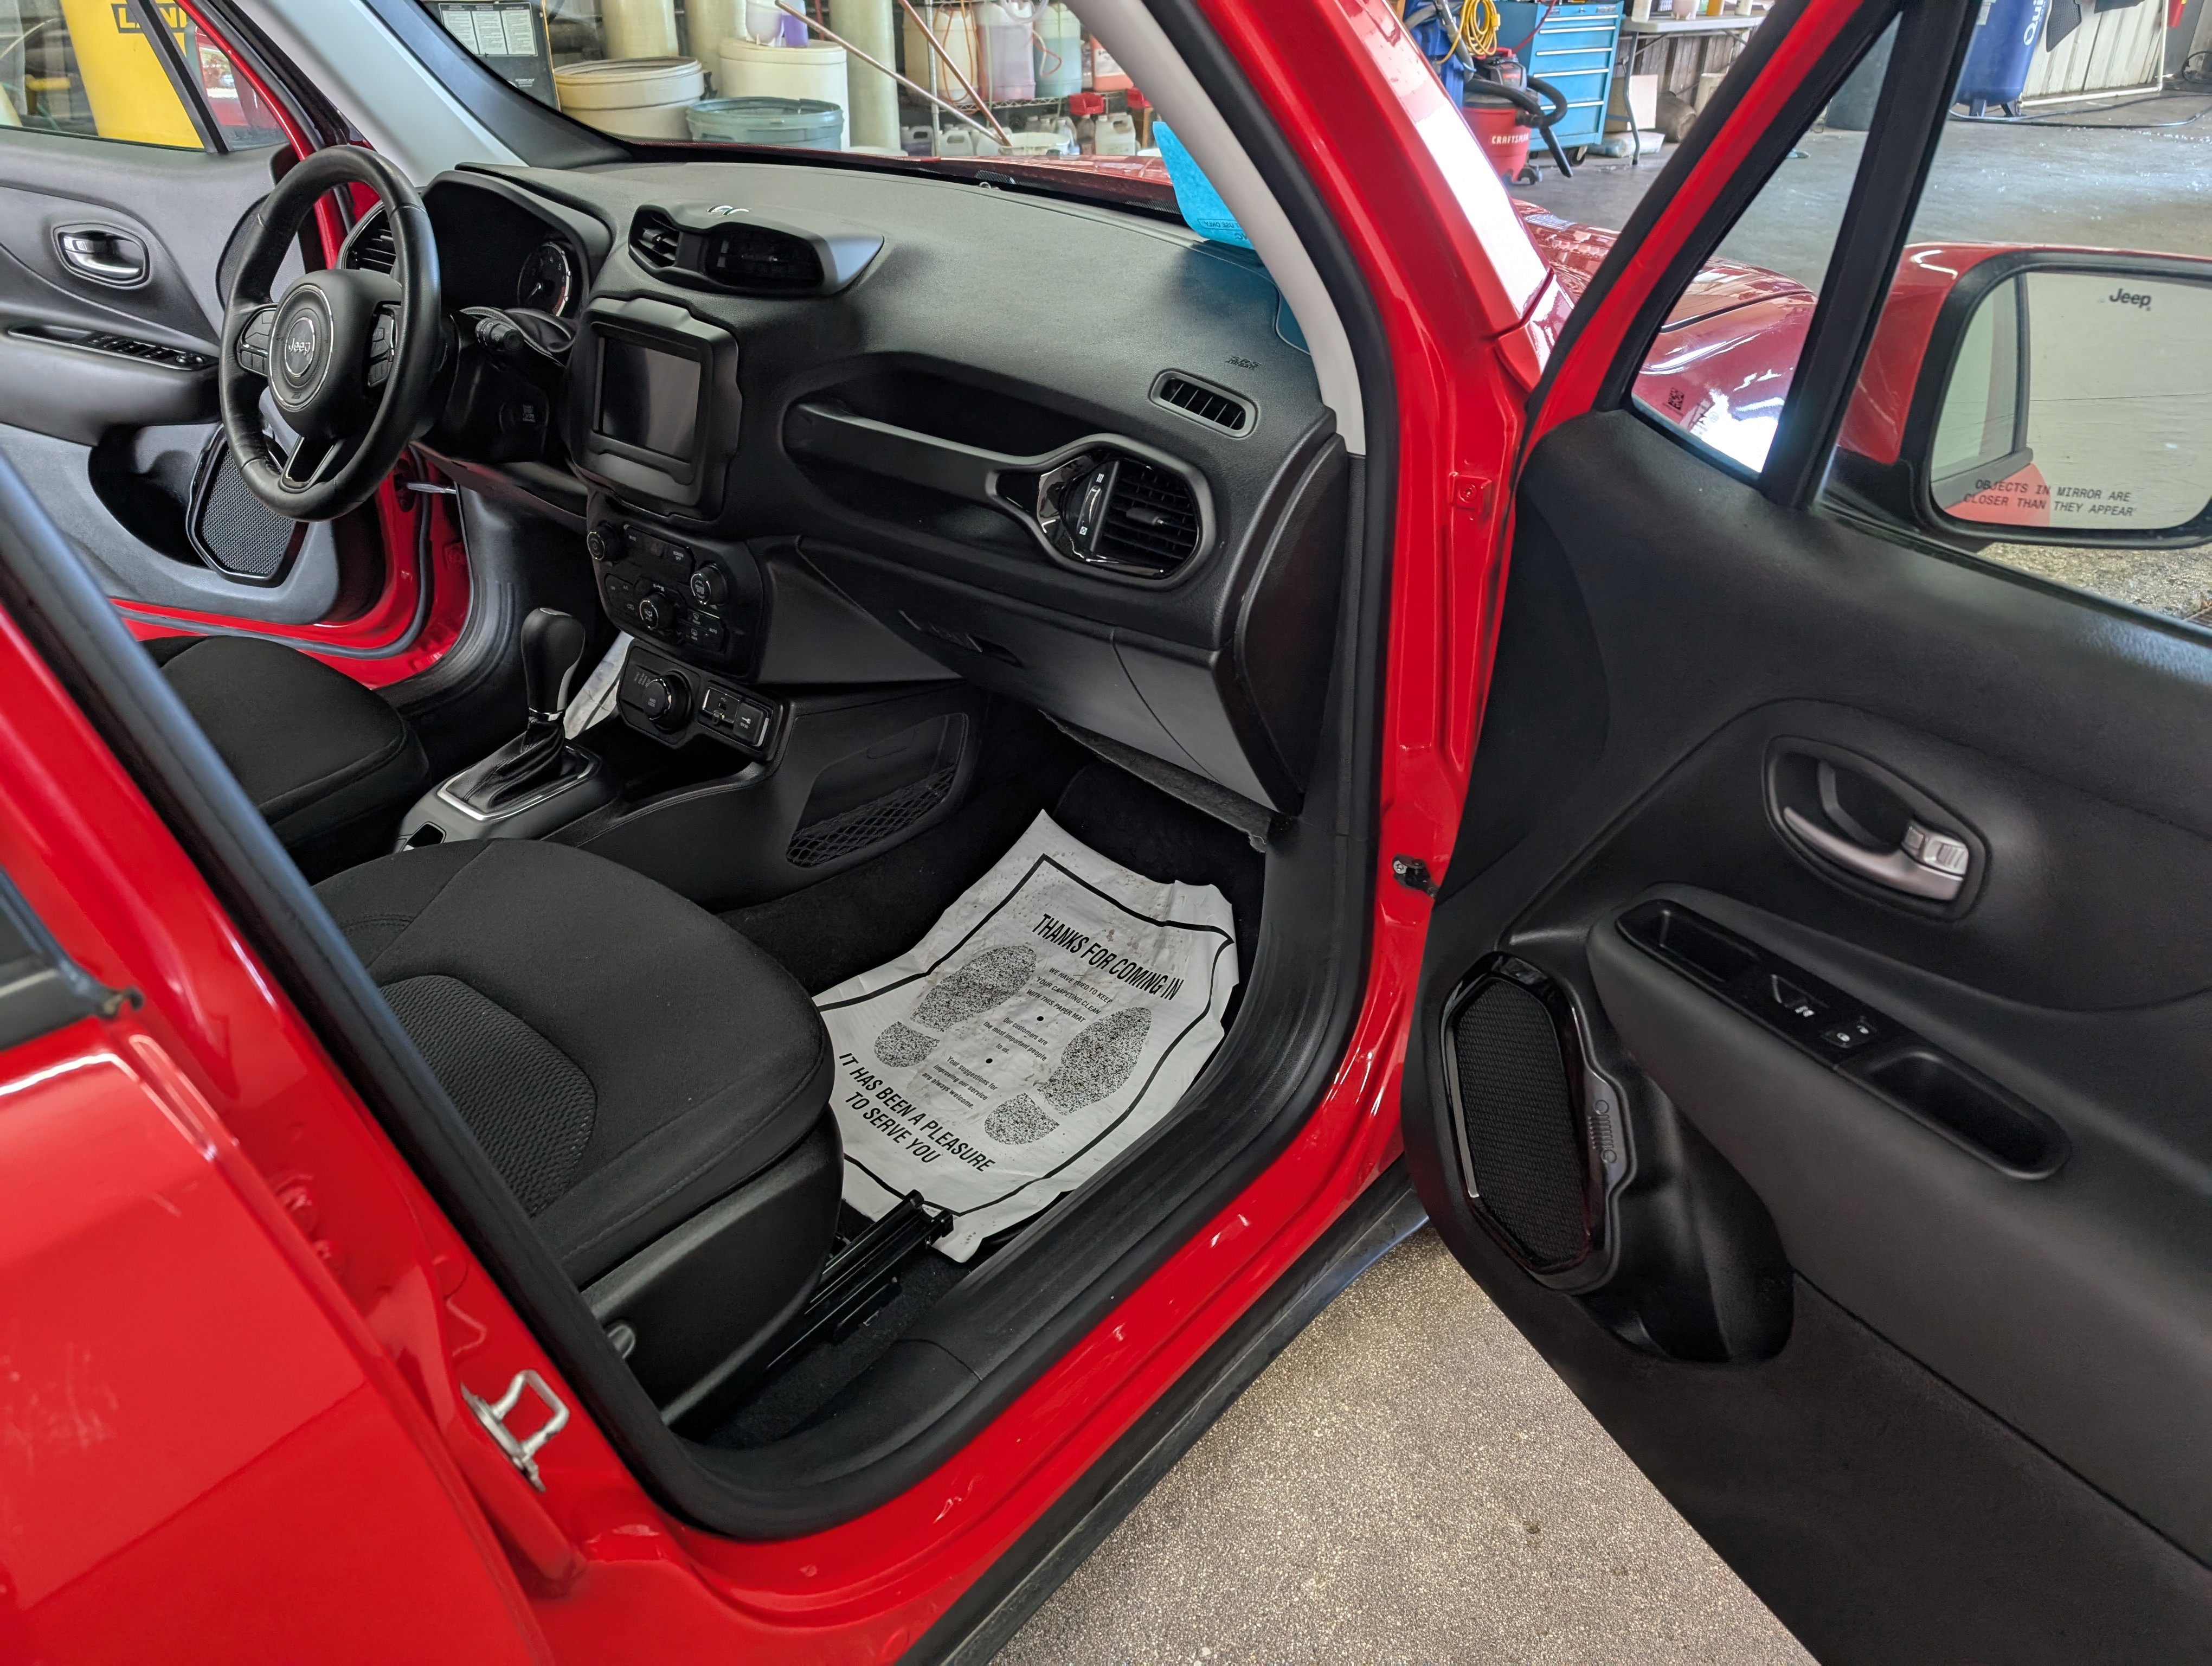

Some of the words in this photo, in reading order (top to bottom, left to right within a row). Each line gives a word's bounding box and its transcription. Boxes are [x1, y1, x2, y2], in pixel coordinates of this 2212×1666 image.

[2109, 288, 2151, 309] Jeep
[288, 337, 311, 356] Jeep
[1964, 493, 2009, 506] CLOSER
[2017, 497, 2048, 510] THAN
[2054, 501, 2084, 512] THEY
[2088, 504, 2134, 516] APPEAR
[1975, 479, 2029, 492] OBJECTS
[2035, 484, 2051, 495] IN
[2056, 486, 2102, 499] MIRROR
[2107, 491, 2132, 502] ARE
[1032, 913, 1089, 953] THANKS
[1080, 942, 1117, 970] FOR
[1109, 958, 1168, 995] COMING
[1160, 977, 1185, 1001] IN
[1036, 977, 1053, 988] YOUR
[1051, 985, 1083, 1003] CARPETING
[1081, 1001, 1101, 1015] CLEAN
[1049, 967, 1060, 976] WE
[1058, 972, 1075, 984] HAVE
[1073, 979, 1090, 990] TRIED
[1089, 987, 1098, 995] TO
[1097, 992, 1113, 1004] KEEP
[1026, 989, 1042, 998] WITH
[1041, 996, 1055, 1006] THIS
[1053, 1002, 1073, 1016] PAPER
[1071, 1013, 1086, 1023] MAT
[983, 1021, 993, 1029] the
[992, 1027, 1006, 1036] most
[1004, 1033, 1030, 1049] important
[1027, 1047, 1047, 1061] people
[1012, 1022, 1039, 1040] customers
[1038, 1037, 1048, 1046] are
[933, 1064, 960, 1083] improving
[967, 1086, 988, 1100] service
[947, 1055, 960, 1067] Your
[959, 1065, 990, 1086] suggestions
[922, 1072, 933, 1080] are
[931, 1078, 950, 1092] always
[949, 1090, 974, 1109] welcome.
[839, 1053, 859, 1066] IT
[850, 1067, 883, 1091] HAS
[875, 1086, 917, 1117] BEEN
[908, 1113, 927, 1126] A
[919, 1119, 996, 1172] PLEASURE
[845, 1091, 870, 1110] TO
[863, 1107, 912, 1144] SERVE
[905, 1137, 941, 1163] YOU
